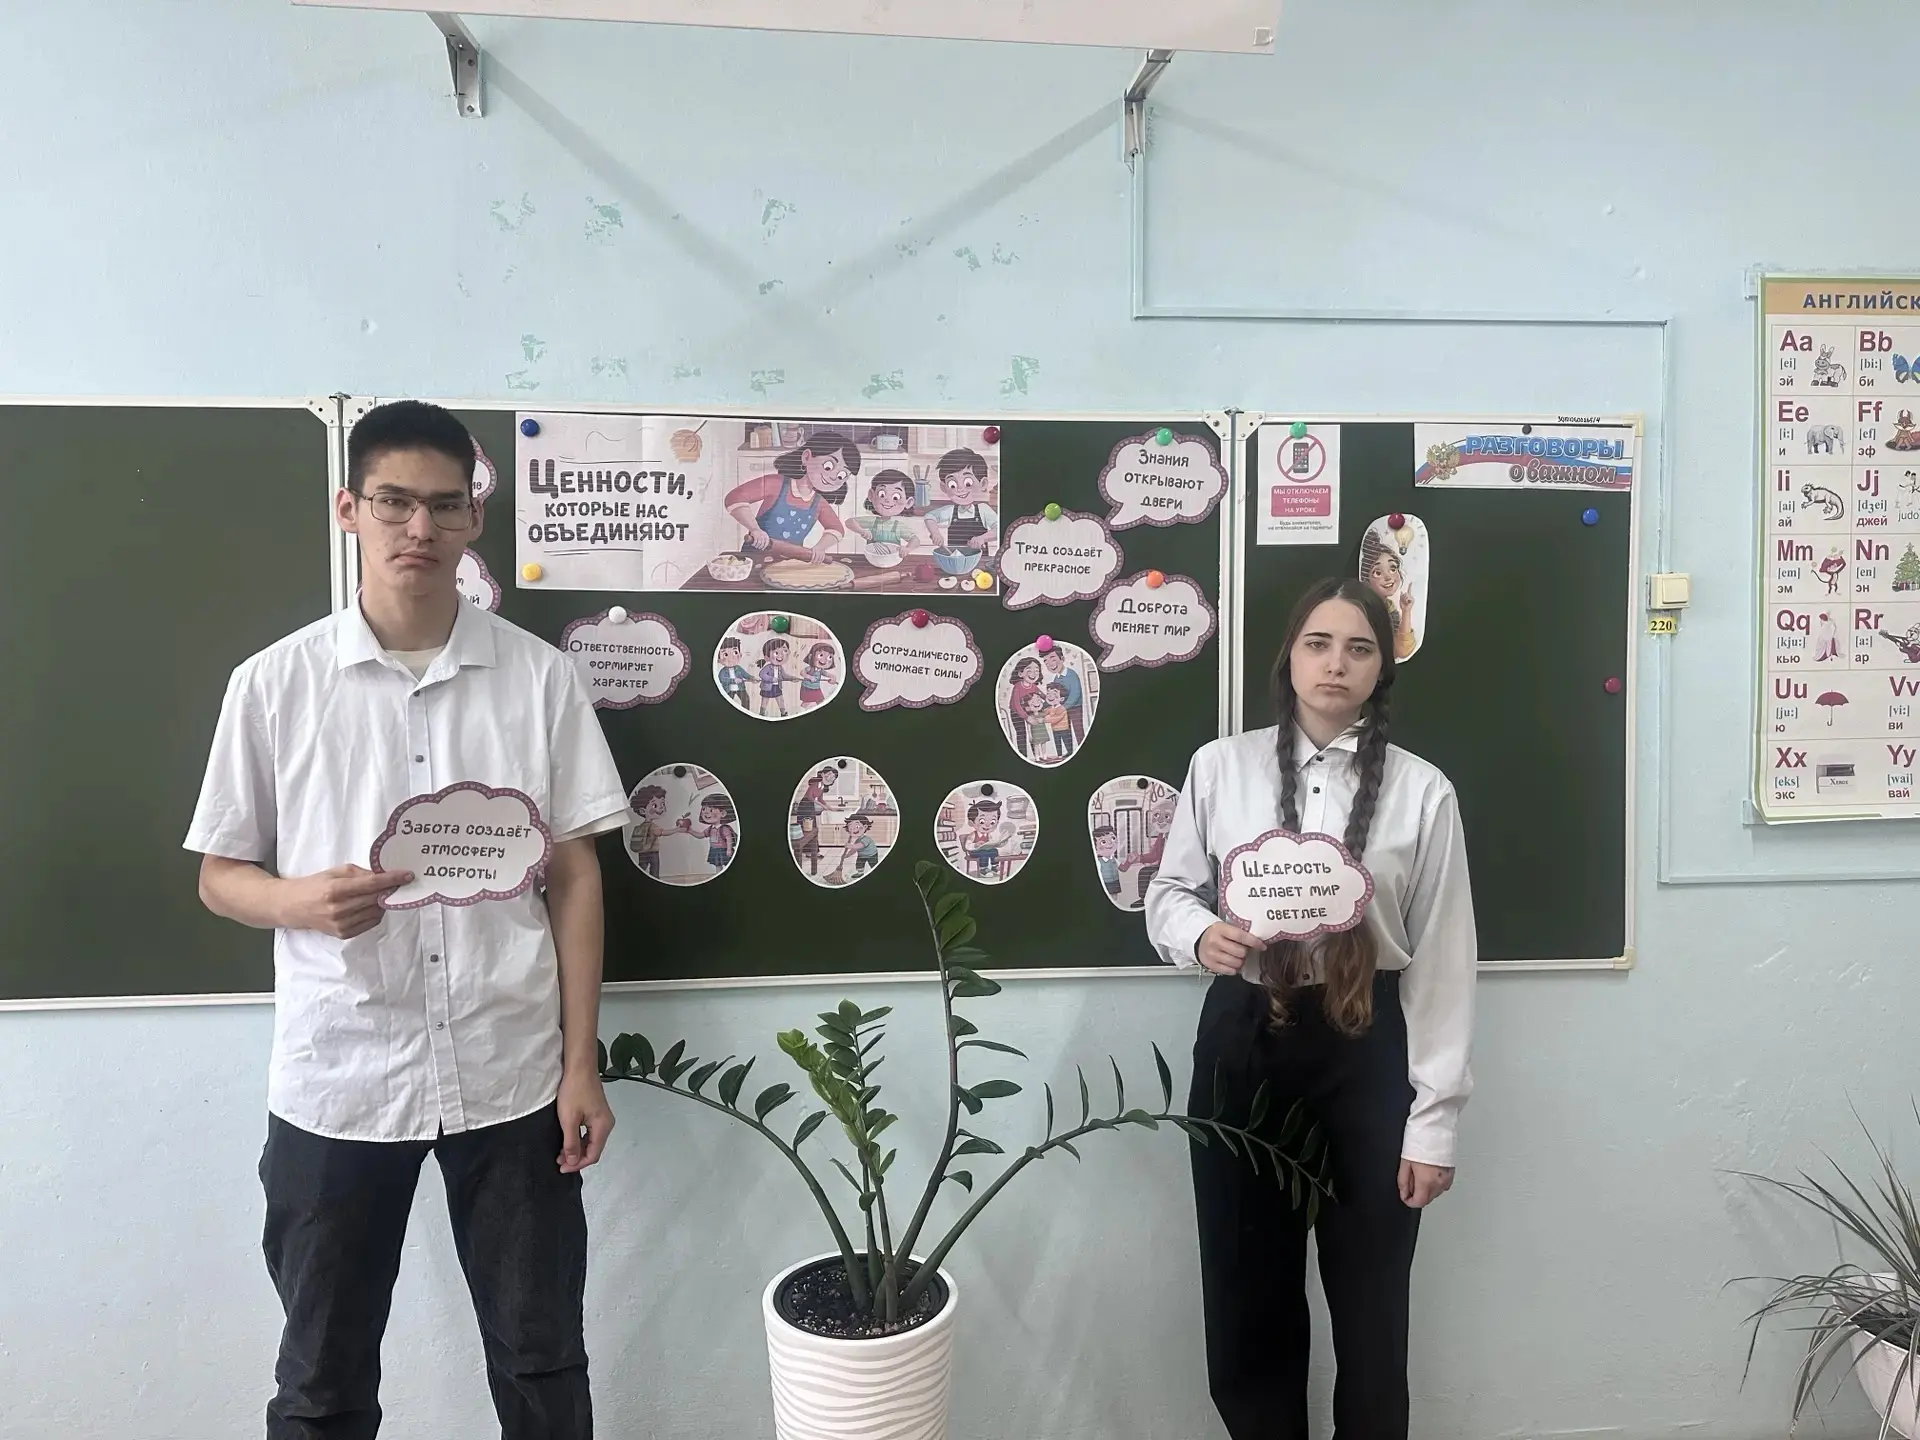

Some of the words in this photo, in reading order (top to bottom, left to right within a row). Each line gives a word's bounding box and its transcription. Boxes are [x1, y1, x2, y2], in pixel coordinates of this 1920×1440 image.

[1803, 290, 1920, 310] АНГЛИЙСК
[1780, 330, 1812, 351] Aa
[1860, 331, 1892, 352] Bb
[1779, 375, 1793, 386] эй
[1859, 375, 1874, 386] би
[1778, 401, 1809, 422] Ee
[1858, 401, 1882, 422] Ff
[1465, 435, 1624, 459] РАЗГОВОРЫ
[1779, 447, 1786, 456] и
[1858, 445, 1876, 458] эф
[1139, 449, 1189, 467] Знания
[1509, 464, 1524, 482] о
[1526, 458, 1617, 484] важном
[1124, 472, 1204, 490] открывают
[1778, 470, 1790, 491] Ii
[1857, 470, 1879, 496] Jj
[1140, 496, 1183, 510] двери
[1778, 516, 1792, 527] ай
[1856, 516, 1887, 527] джей
[1897, 510, 1919, 522] judo
[1015, 542, 1048, 555] Труд
[1053, 546, 1103, 558] создаёт
[1778, 540, 1813, 561] Mm
[1856, 539, 1889, 560] Nn
[1024, 562, 1091, 574] прекрасное
[1777, 585, 1793, 594] эм
[1856, 584, 1870, 593] эн
[1117, 598, 1188, 615] Доброта
[1776, 609, 1810, 635] Qq
[1855, 609, 1884, 630] Rr
[1112, 621, 1159, 635] меняет
[1164, 625, 1191, 637] мир
[570, 640, 675, 657] Ответственность
[872, 642, 968, 664] Сотрудничество
[589, 660, 653, 672] формирует
[1777, 655, 1800, 664] кью
[1855, 654, 1870, 664] ар
[874, 661, 930, 676] умножает
[934, 668, 962, 680] силы
[592, 678, 648, 689] характер
[1775, 678, 1807, 699] Uu
[1889, 676, 1920, 696] Vv
[1775, 724, 1785, 732] ю
[1888, 722, 1903, 730] ви
[1775, 747, 1807, 768] Xx
[1887, 745, 1916, 768] Yy
[1775, 791, 1795, 800] экс
[1888, 788, 1910, 798] вай
[401, 819, 460, 835] Забота
[466, 824, 531, 838] создаёт
[421, 844, 505, 858] атмосферу
[424, 865, 497, 880] доброты
[1242, 860, 1331, 877] Щедрость
[1248, 886, 1303, 898] делает
[1309, 884, 1340, 897] мир
[1266, 907, 1327, 920] светлее
